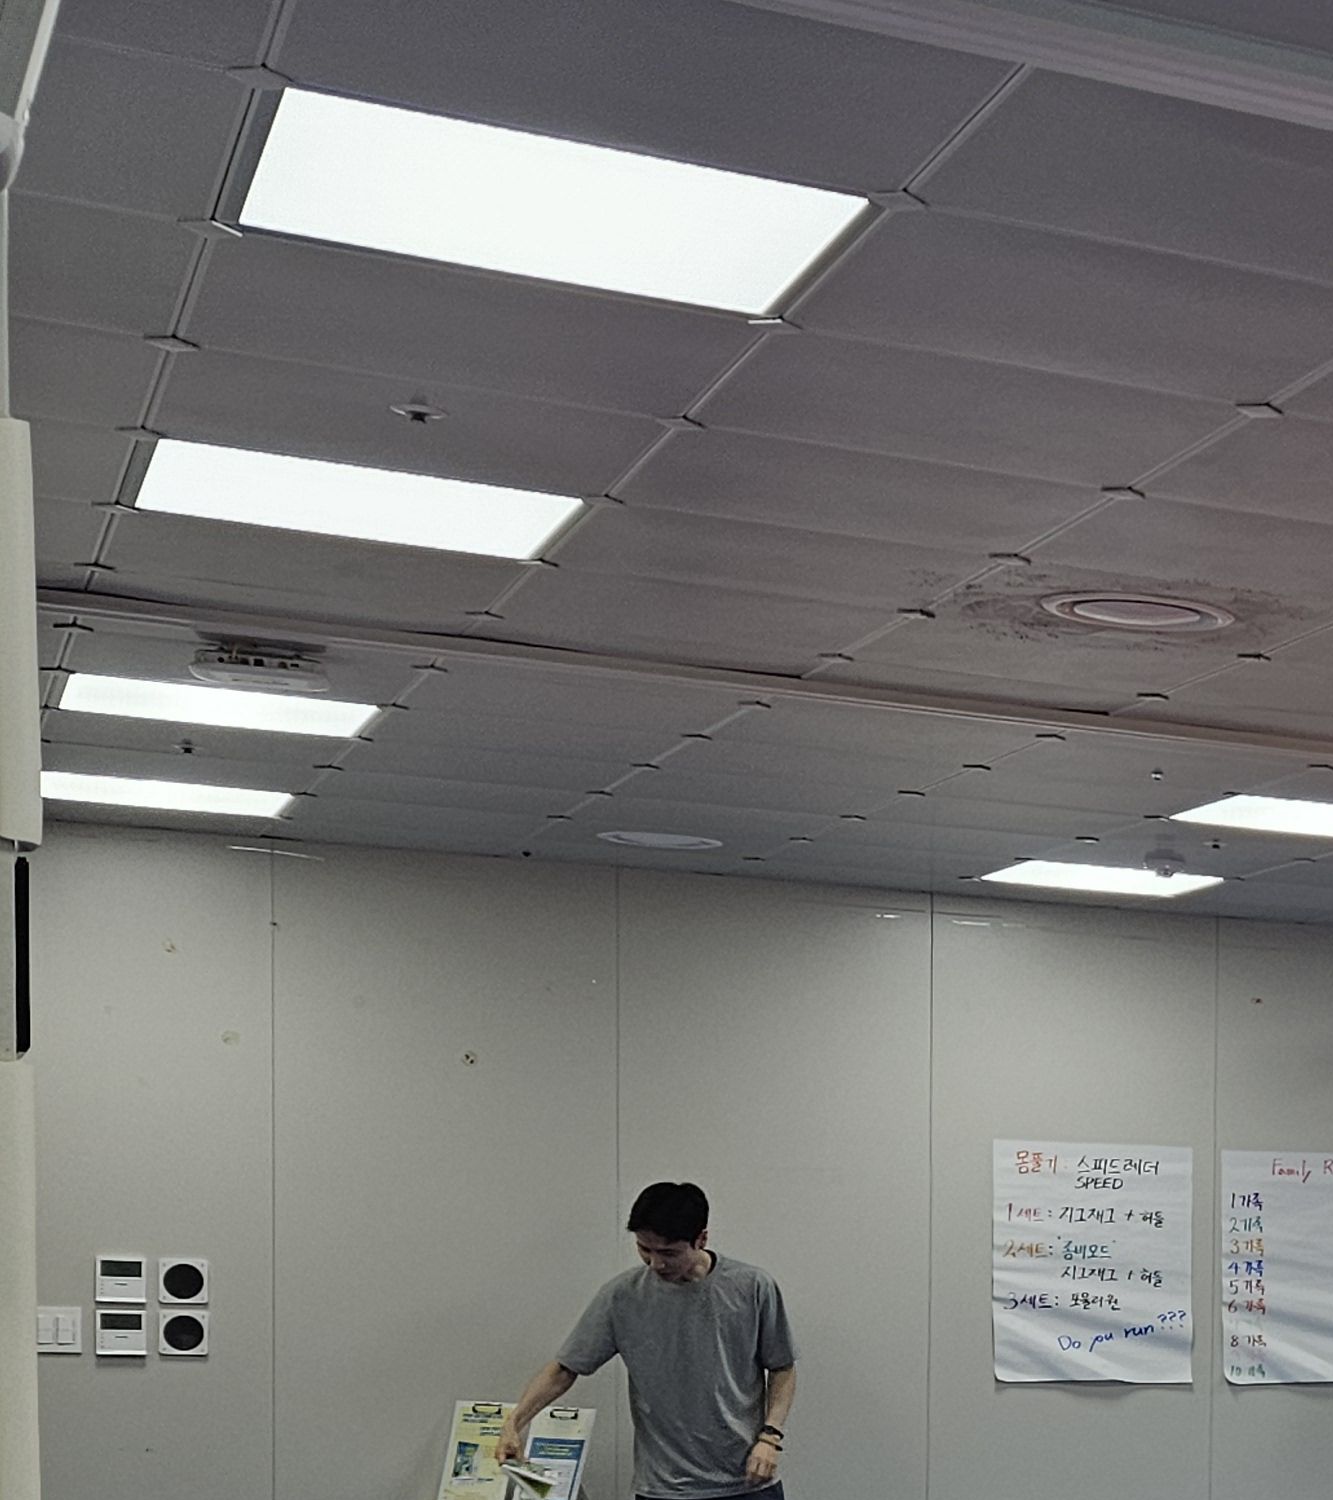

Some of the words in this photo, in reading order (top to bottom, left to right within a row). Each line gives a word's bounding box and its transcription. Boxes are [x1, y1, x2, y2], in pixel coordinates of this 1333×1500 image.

[1074, 1175, 1124, 1190] SPEED
[1141, 1210, 1166, 1229] 허들
[1057, 1334, 1082, 1352] Do
